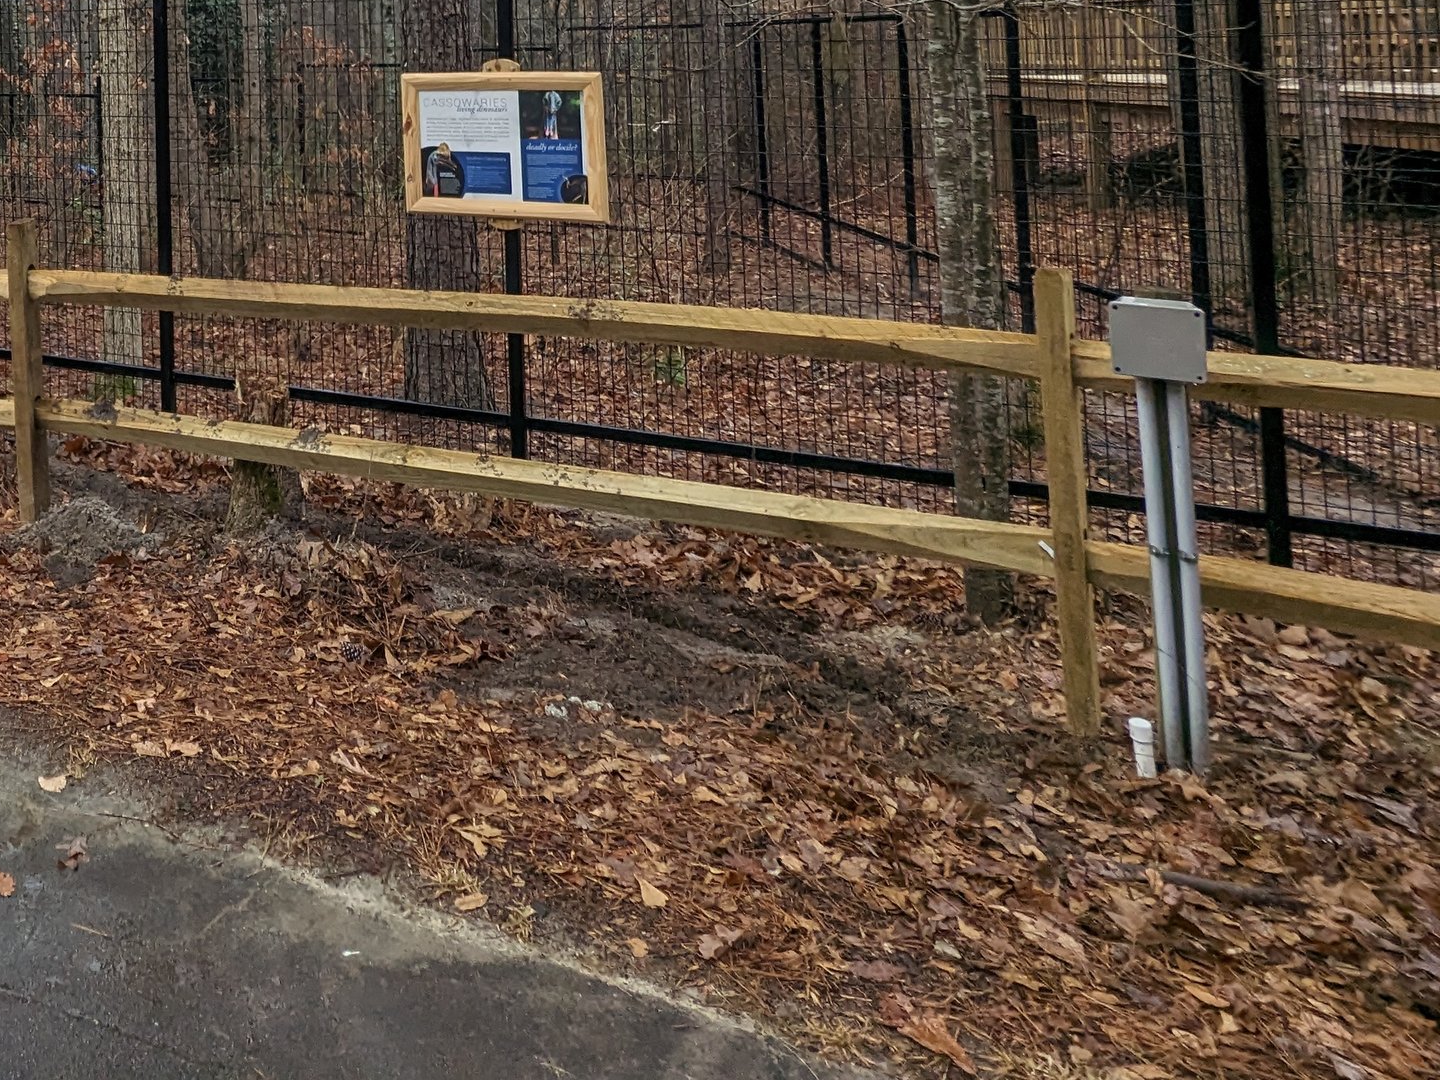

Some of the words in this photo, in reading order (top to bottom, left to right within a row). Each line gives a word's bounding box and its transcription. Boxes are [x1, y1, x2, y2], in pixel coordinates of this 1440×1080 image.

[423, 97, 507, 108] CASSOWARIES
[456, 105, 475, 114] living
[476, 105, 508, 113] dinosaurs
[526, 142, 547, 153] deadly
[555, 143, 578, 152] docile?
